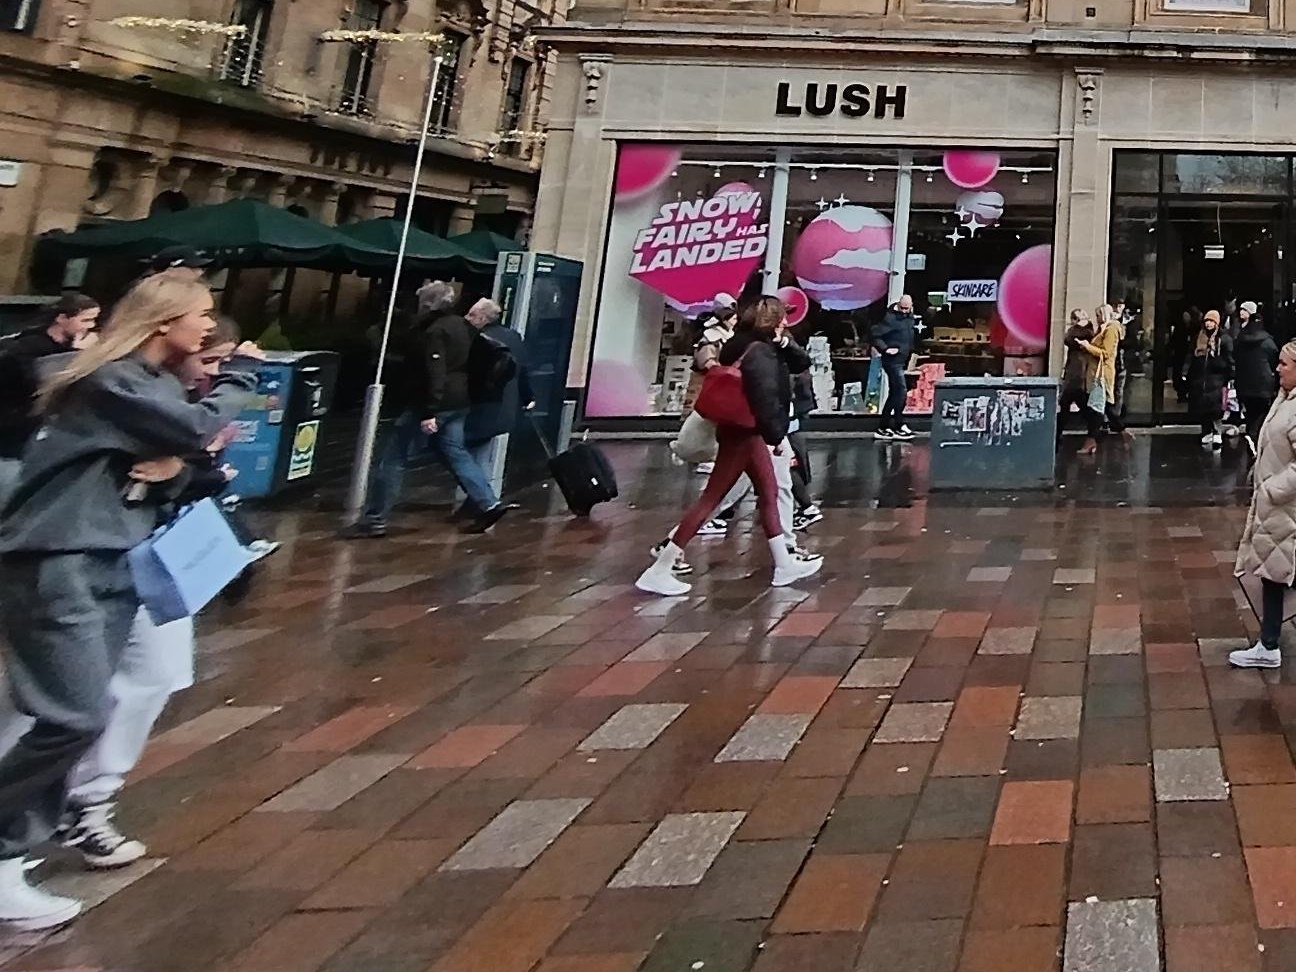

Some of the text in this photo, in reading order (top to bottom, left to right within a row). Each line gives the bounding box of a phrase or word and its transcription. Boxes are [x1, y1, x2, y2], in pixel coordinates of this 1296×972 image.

[775, 82, 907, 119] LUSH
[652, 191, 760, 225] SNOW
[633, 217, 769, 251] FAIRY HAS
[629, 235, 768, 274] LANDED
[950, 282, 995, 298] SKINCARE
